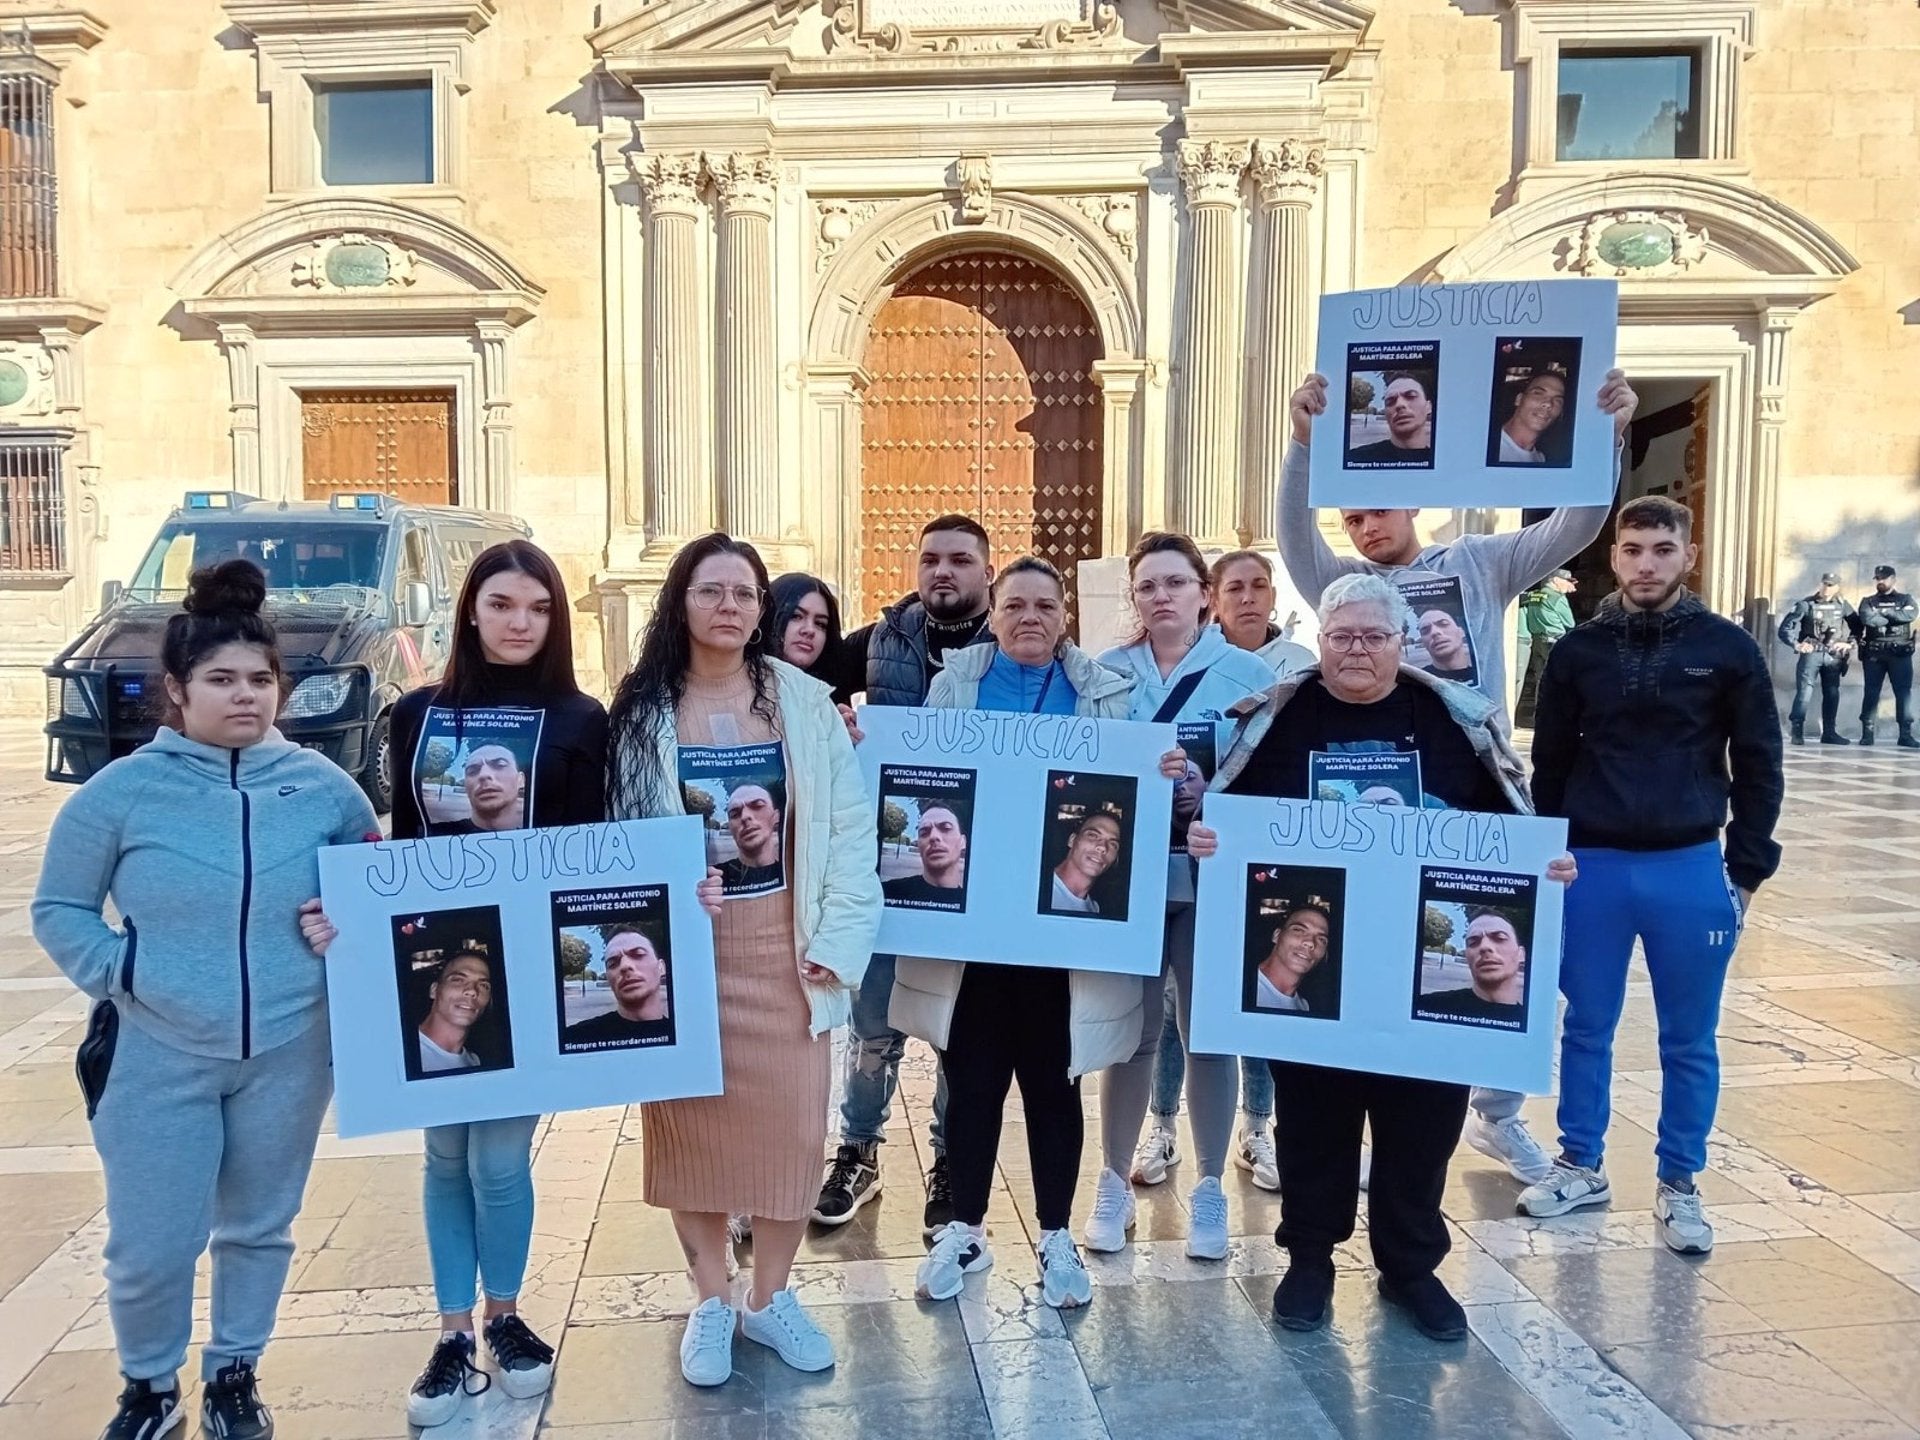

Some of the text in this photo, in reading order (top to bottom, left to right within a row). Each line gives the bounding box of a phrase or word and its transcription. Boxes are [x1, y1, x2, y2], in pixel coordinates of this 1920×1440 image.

[1351, 344, 1434, 354] JUSTICIA PARA ANTONIO
[1359, 352, 1423, 361] MARTÍNEZ SOLERA
[1347, 461, 1372, 469] Siempre
[1426, 581, 1454, 590] ANTONIO
[473, 713, 495, 721] PARA
[496, 713, 535, 722] ANTONIO
[442, 720, 520, 728] MATÍNEZ SOLERA
[1178, 725, 1210, 733] ANTONIO
[681, 748, 777, 760] JUSTICIA PARA ANTONIO
[692, 757, 767, 768] MARTÍNEZ SOLERA
[1375, 756, 1410, 764] ANTONIO
[1326, 763, 1366, 771] MARTÍNEZ
[884, 768, 971, 780] JUSTICIA PARA ANTONIO
[893, 777, 959, 788] MARTÍNEZ SOLERA
[1424, 870, 1530, 887] JUSTICIA PARA ANTONIO
[1435, 880, 1516, 895] MARTÍNEZ SOLERA
[556, 889, 661, 904] JUSTICIA PARA ANTONIO
[567, 900, 648, 913] MARTÍNEZ SOLERA
[1416, 1009, 1449, 1020] Siempre
[565, 1041, 597, 1051] Siempre
[225, 1370, 246, 1383] EA7
